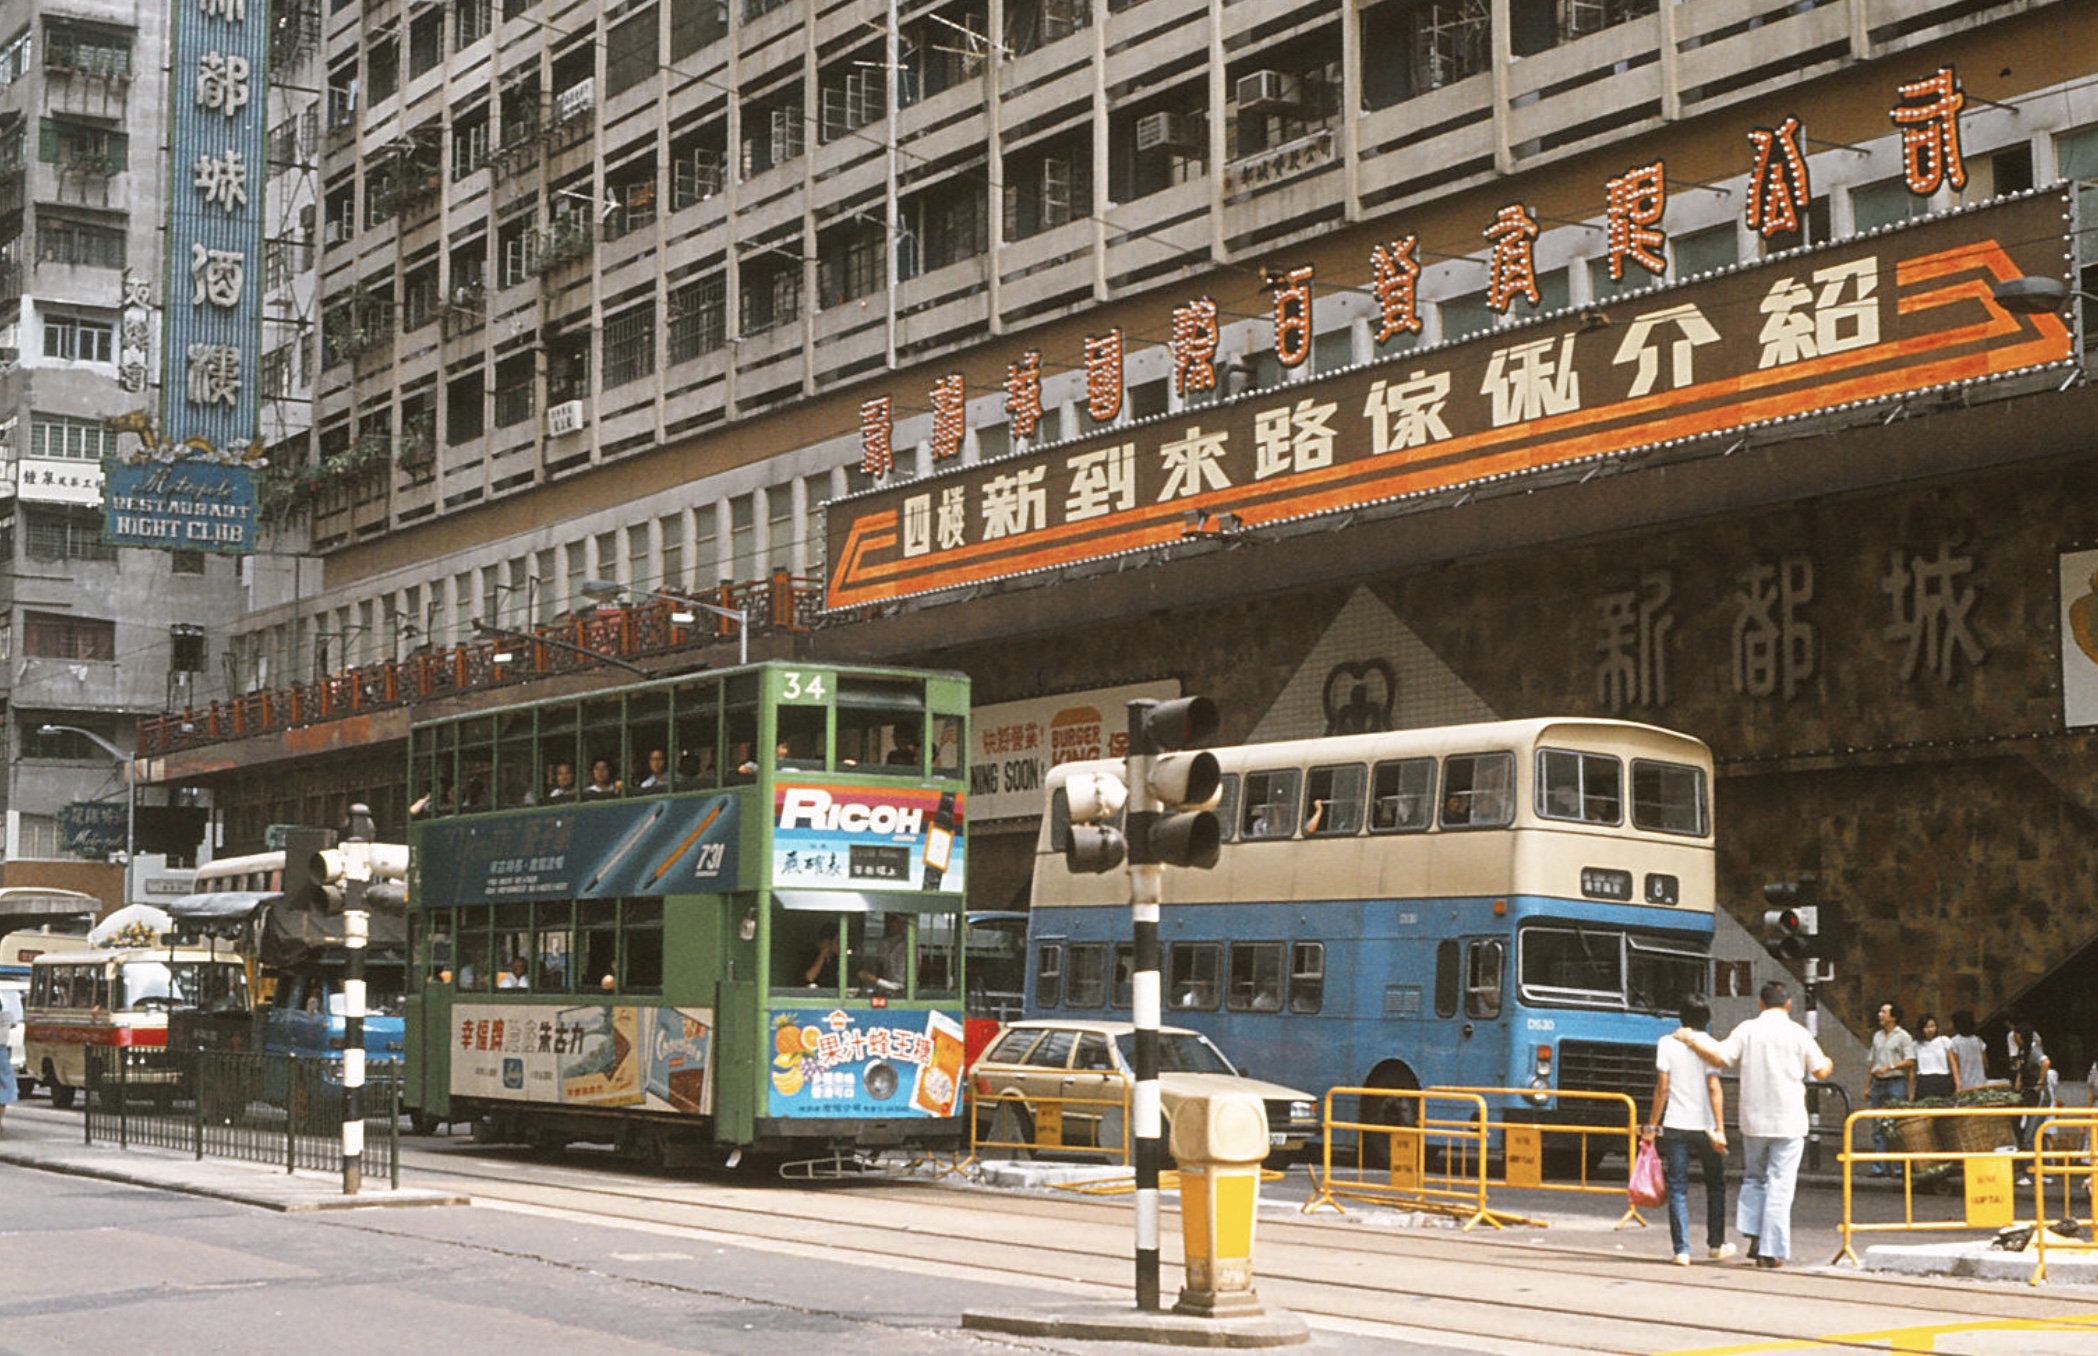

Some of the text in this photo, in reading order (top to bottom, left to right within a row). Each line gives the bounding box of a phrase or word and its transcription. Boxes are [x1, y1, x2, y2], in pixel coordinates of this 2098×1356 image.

[112, 496, 250, 519] RESTAURANT
[116, 516, 243, 543] NIGHT CLUB
[1600, 540, 1989, 709] 新都城
[782, 672, 826, 702] 34
[1052, 725, 1101, 749] BURGER
[780, 788, 923, 835] RICOH
[697, 843, 725, 870] 731
[818, 1029, 935, 1067] 果汁蜂王糖
